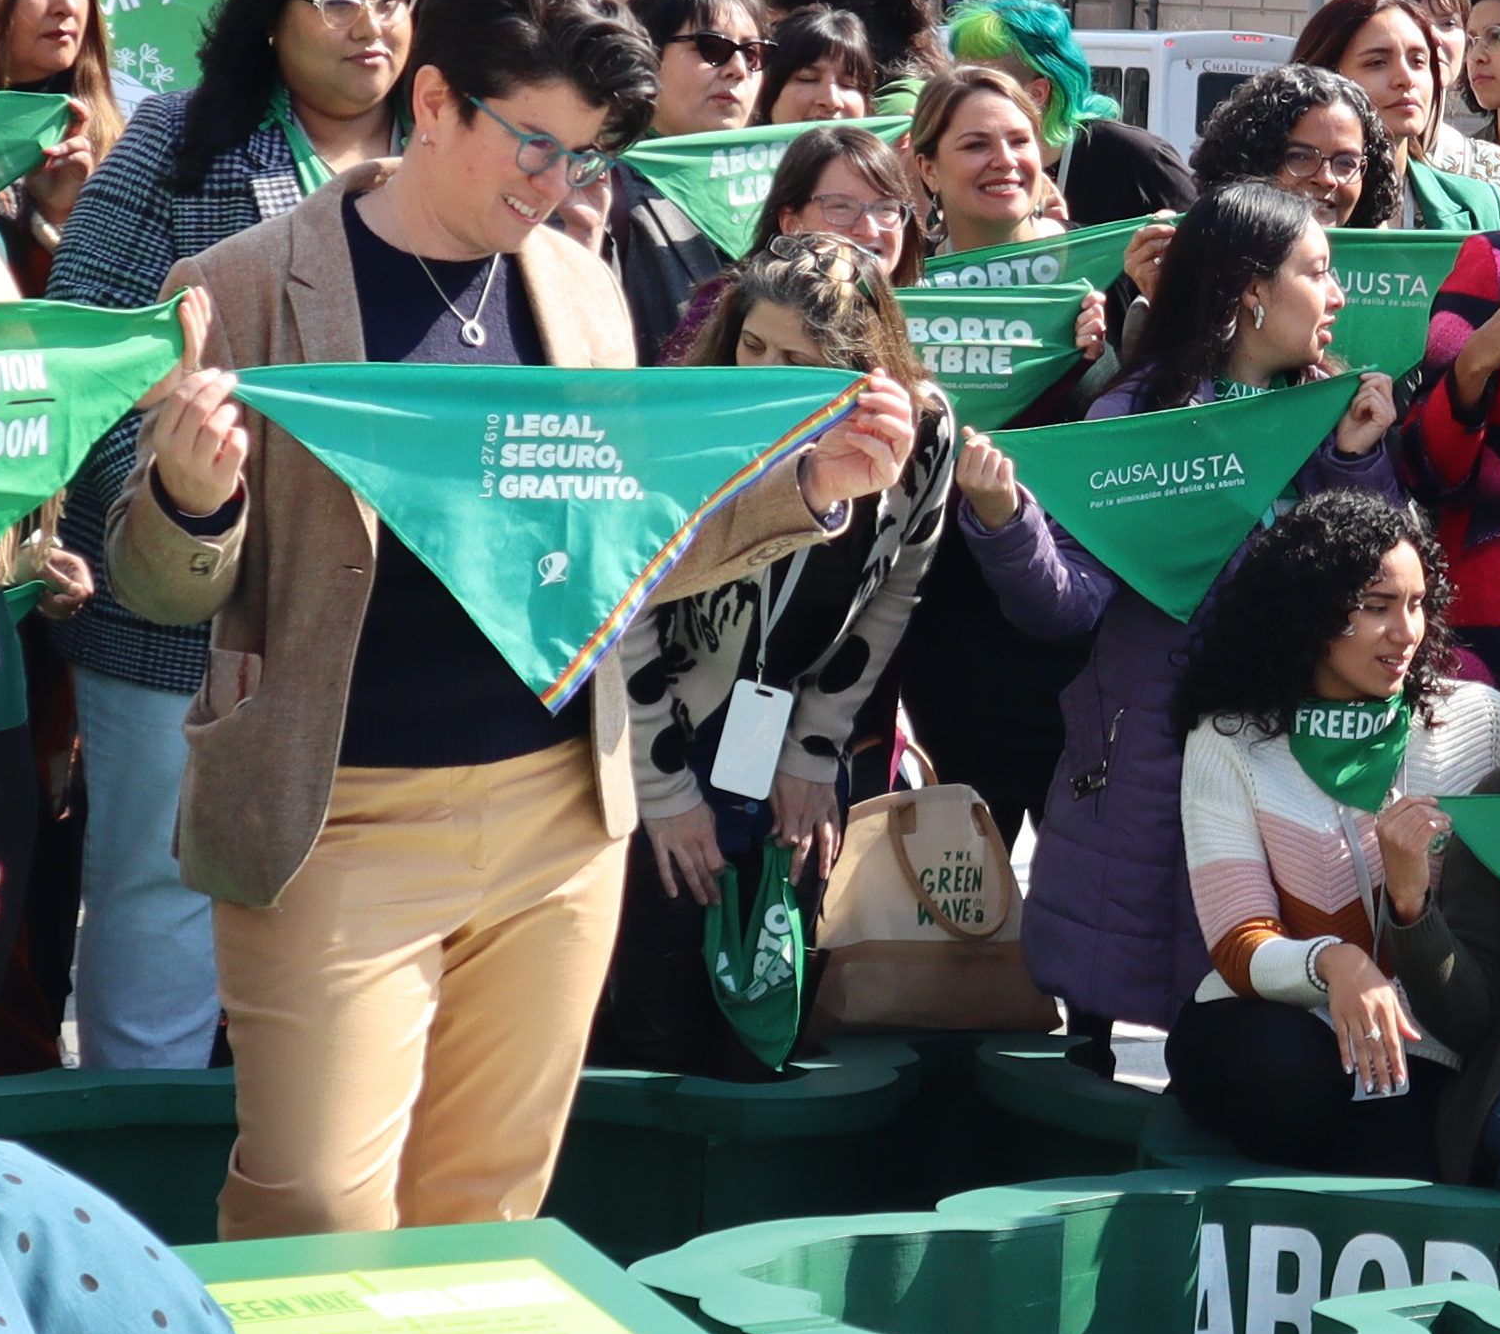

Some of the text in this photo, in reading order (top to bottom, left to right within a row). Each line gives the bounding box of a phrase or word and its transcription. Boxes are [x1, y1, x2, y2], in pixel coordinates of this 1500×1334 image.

[918, 255, 1060, 288] BORTO
[504, 414, 606, 443] LEGAL,
[478, 413, 500, 499] Ley 27.610
[500, 443, 623, 474] SEGURO,
[1089, 452, 1245, 491] CAUSAJUSTA
[498, 474, 645, 501] GRATUITO.
[1089, 496, 1105, 510] Por
[1164, 486, 1178, 497] del
[1178, 483, 1202, 496] delito
[1204, 481, 1216, 491] de
[1218, 476, 1247, 489] aborto
[943, 851, 972, 862] THE
[918, 865, 983, 895] GREEN
